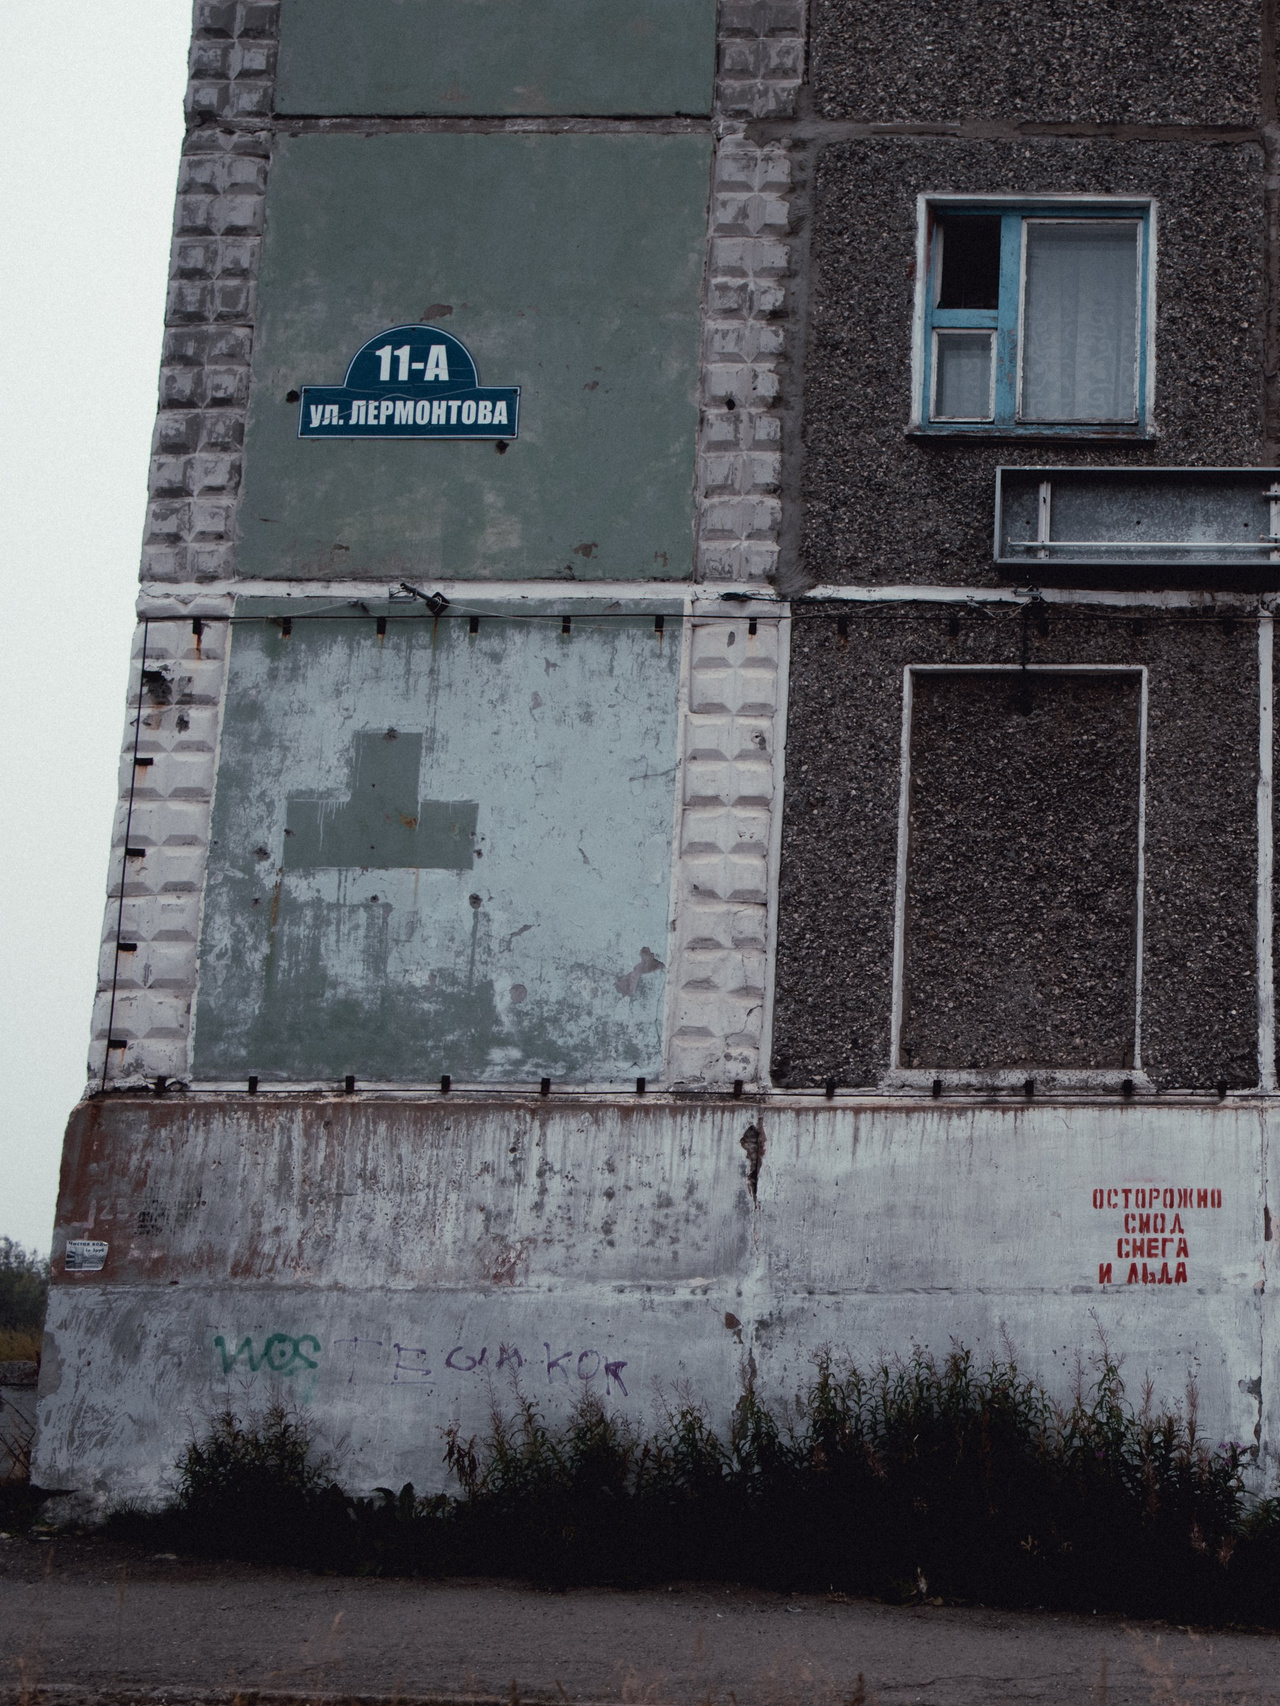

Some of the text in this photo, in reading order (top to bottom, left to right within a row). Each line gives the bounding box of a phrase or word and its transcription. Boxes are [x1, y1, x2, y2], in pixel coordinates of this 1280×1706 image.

[375, 344, 449, 381] 11-А
[349, 400, 508, 425] ЛЕРМОНТОВА
[1092, 1187, 1222, 1210] ОСТОРОЖНО
[1116, 1237, 1189, 1259] СНЕГА
[1098, 1261, 1188, 1285] И ЛЬДА
